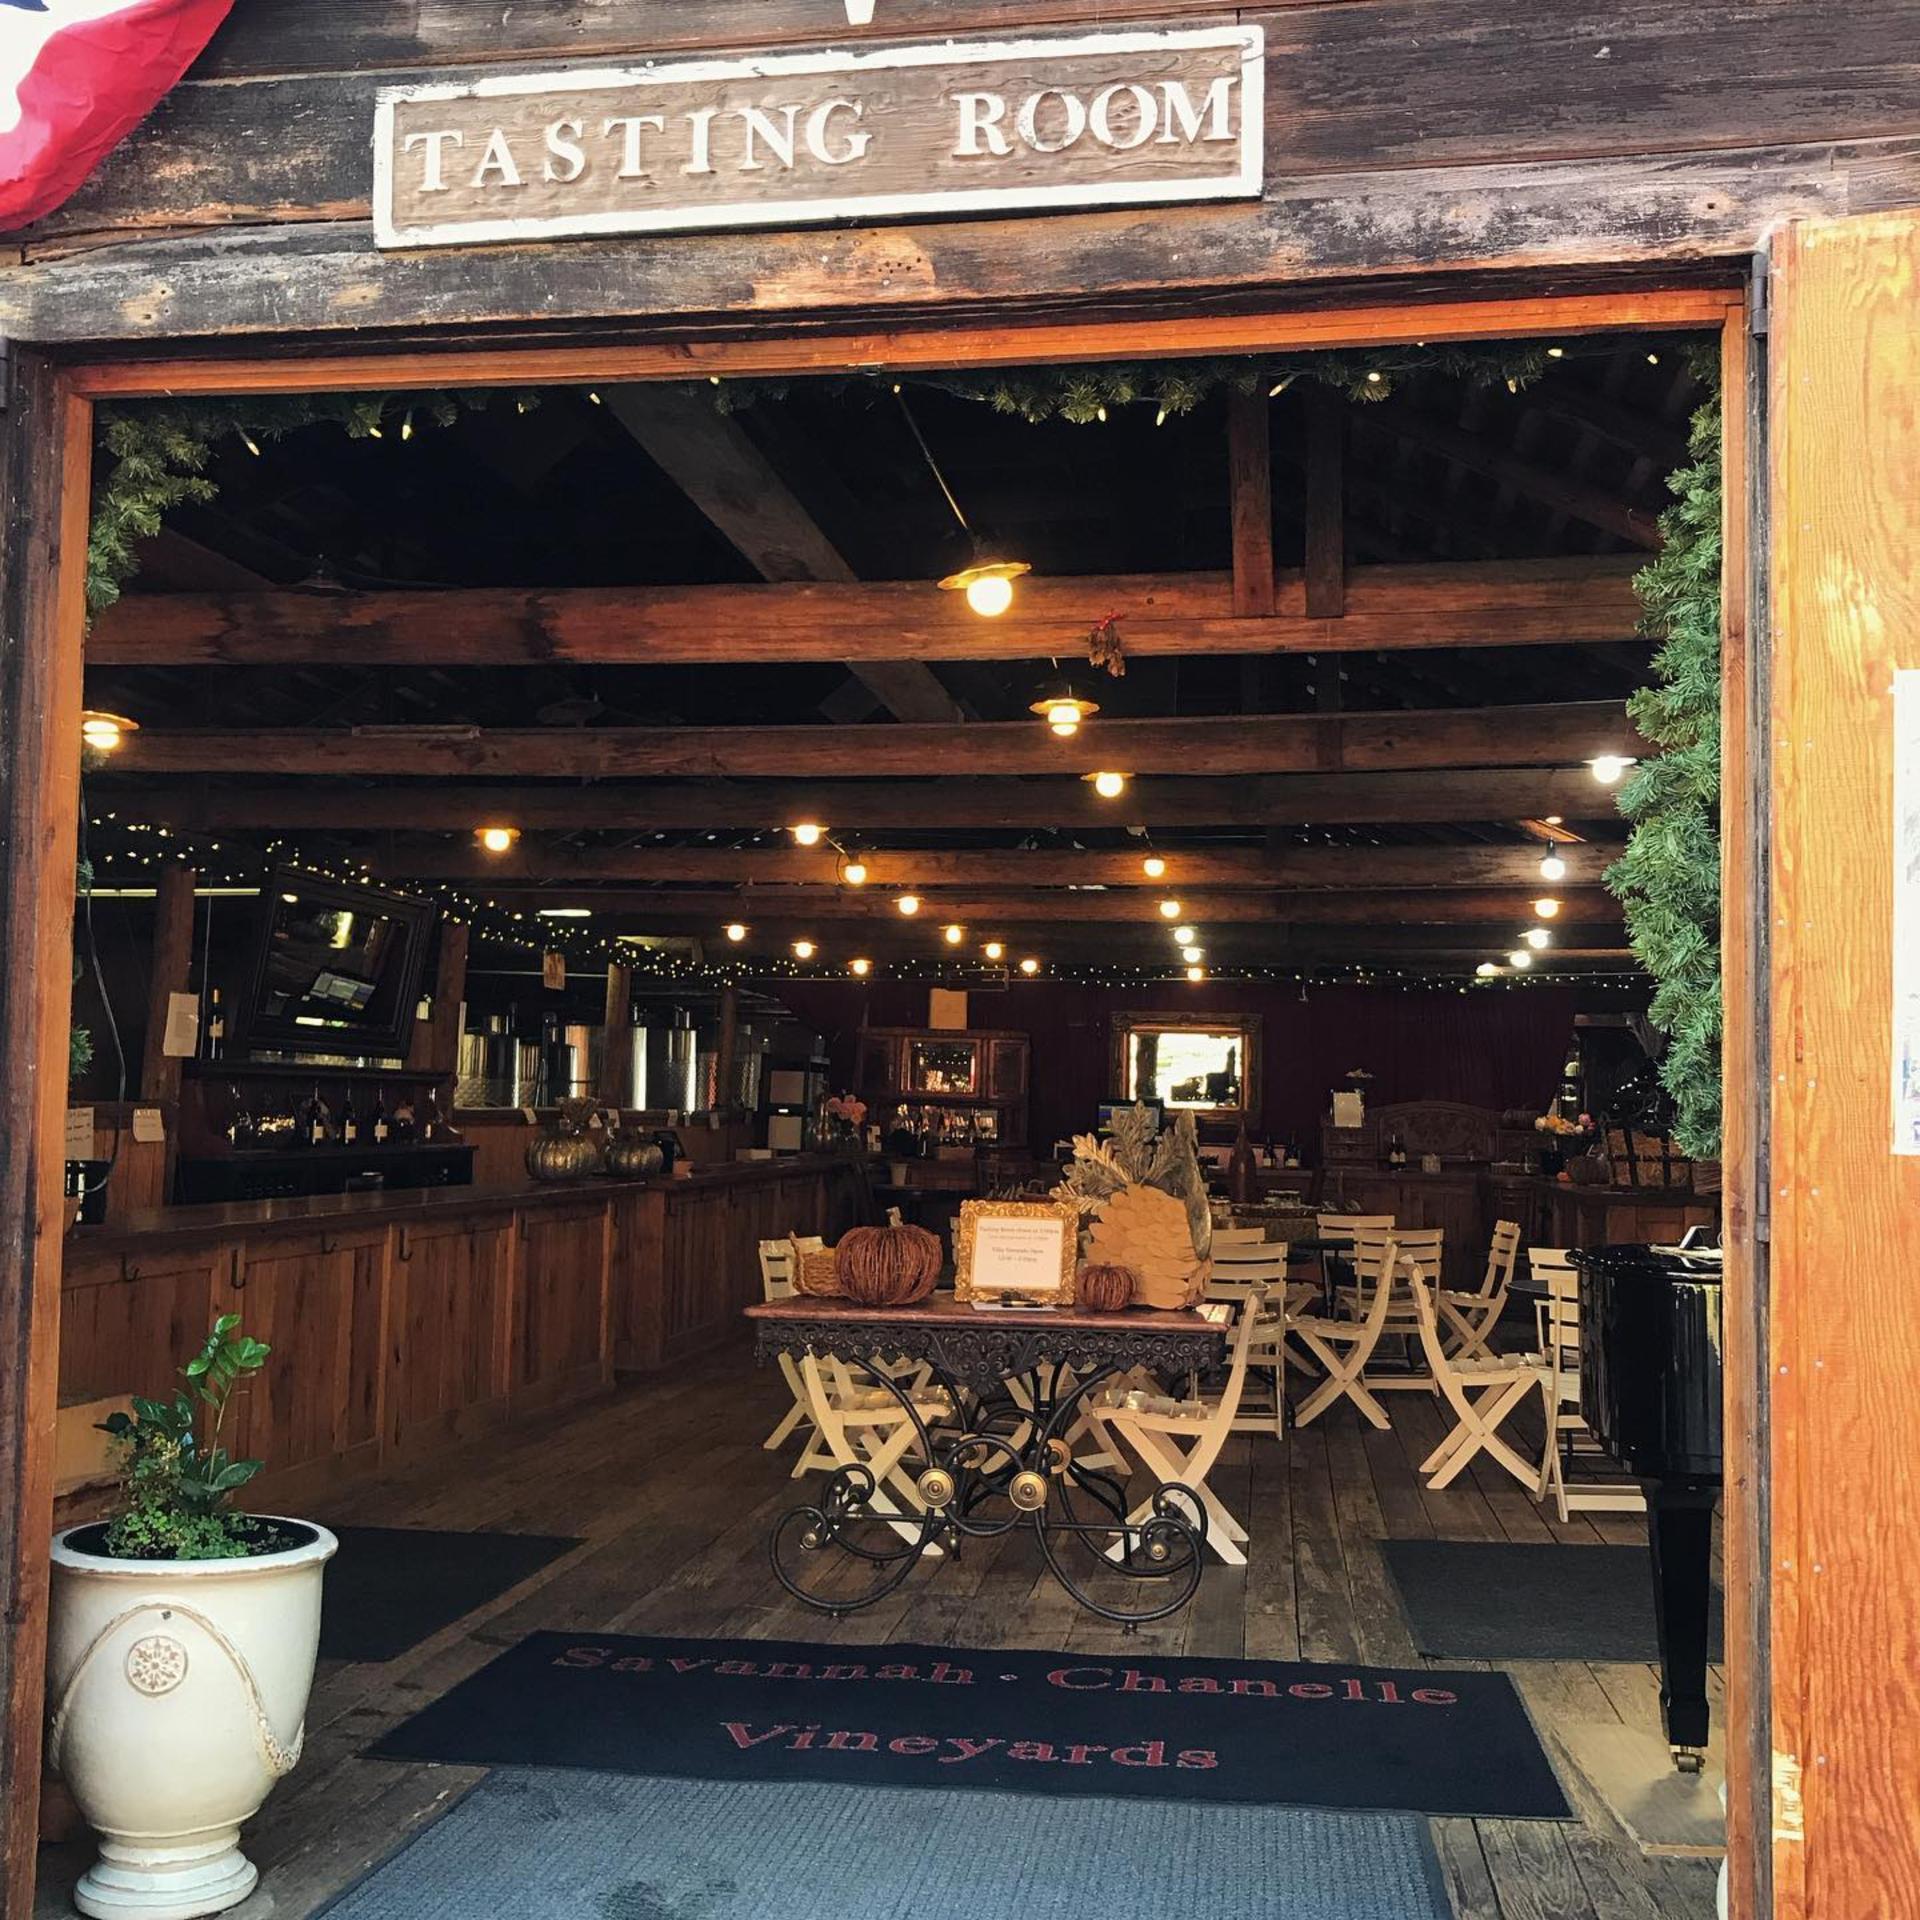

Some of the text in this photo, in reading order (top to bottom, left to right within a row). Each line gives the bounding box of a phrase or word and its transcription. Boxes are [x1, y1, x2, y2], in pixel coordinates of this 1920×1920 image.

[404, 76, 1239, 193] TASTING ROOM
[551, 1646, 1458, 1705] Savannah Chanelle
[719, 1721, 1219, 1769] Vineyards
